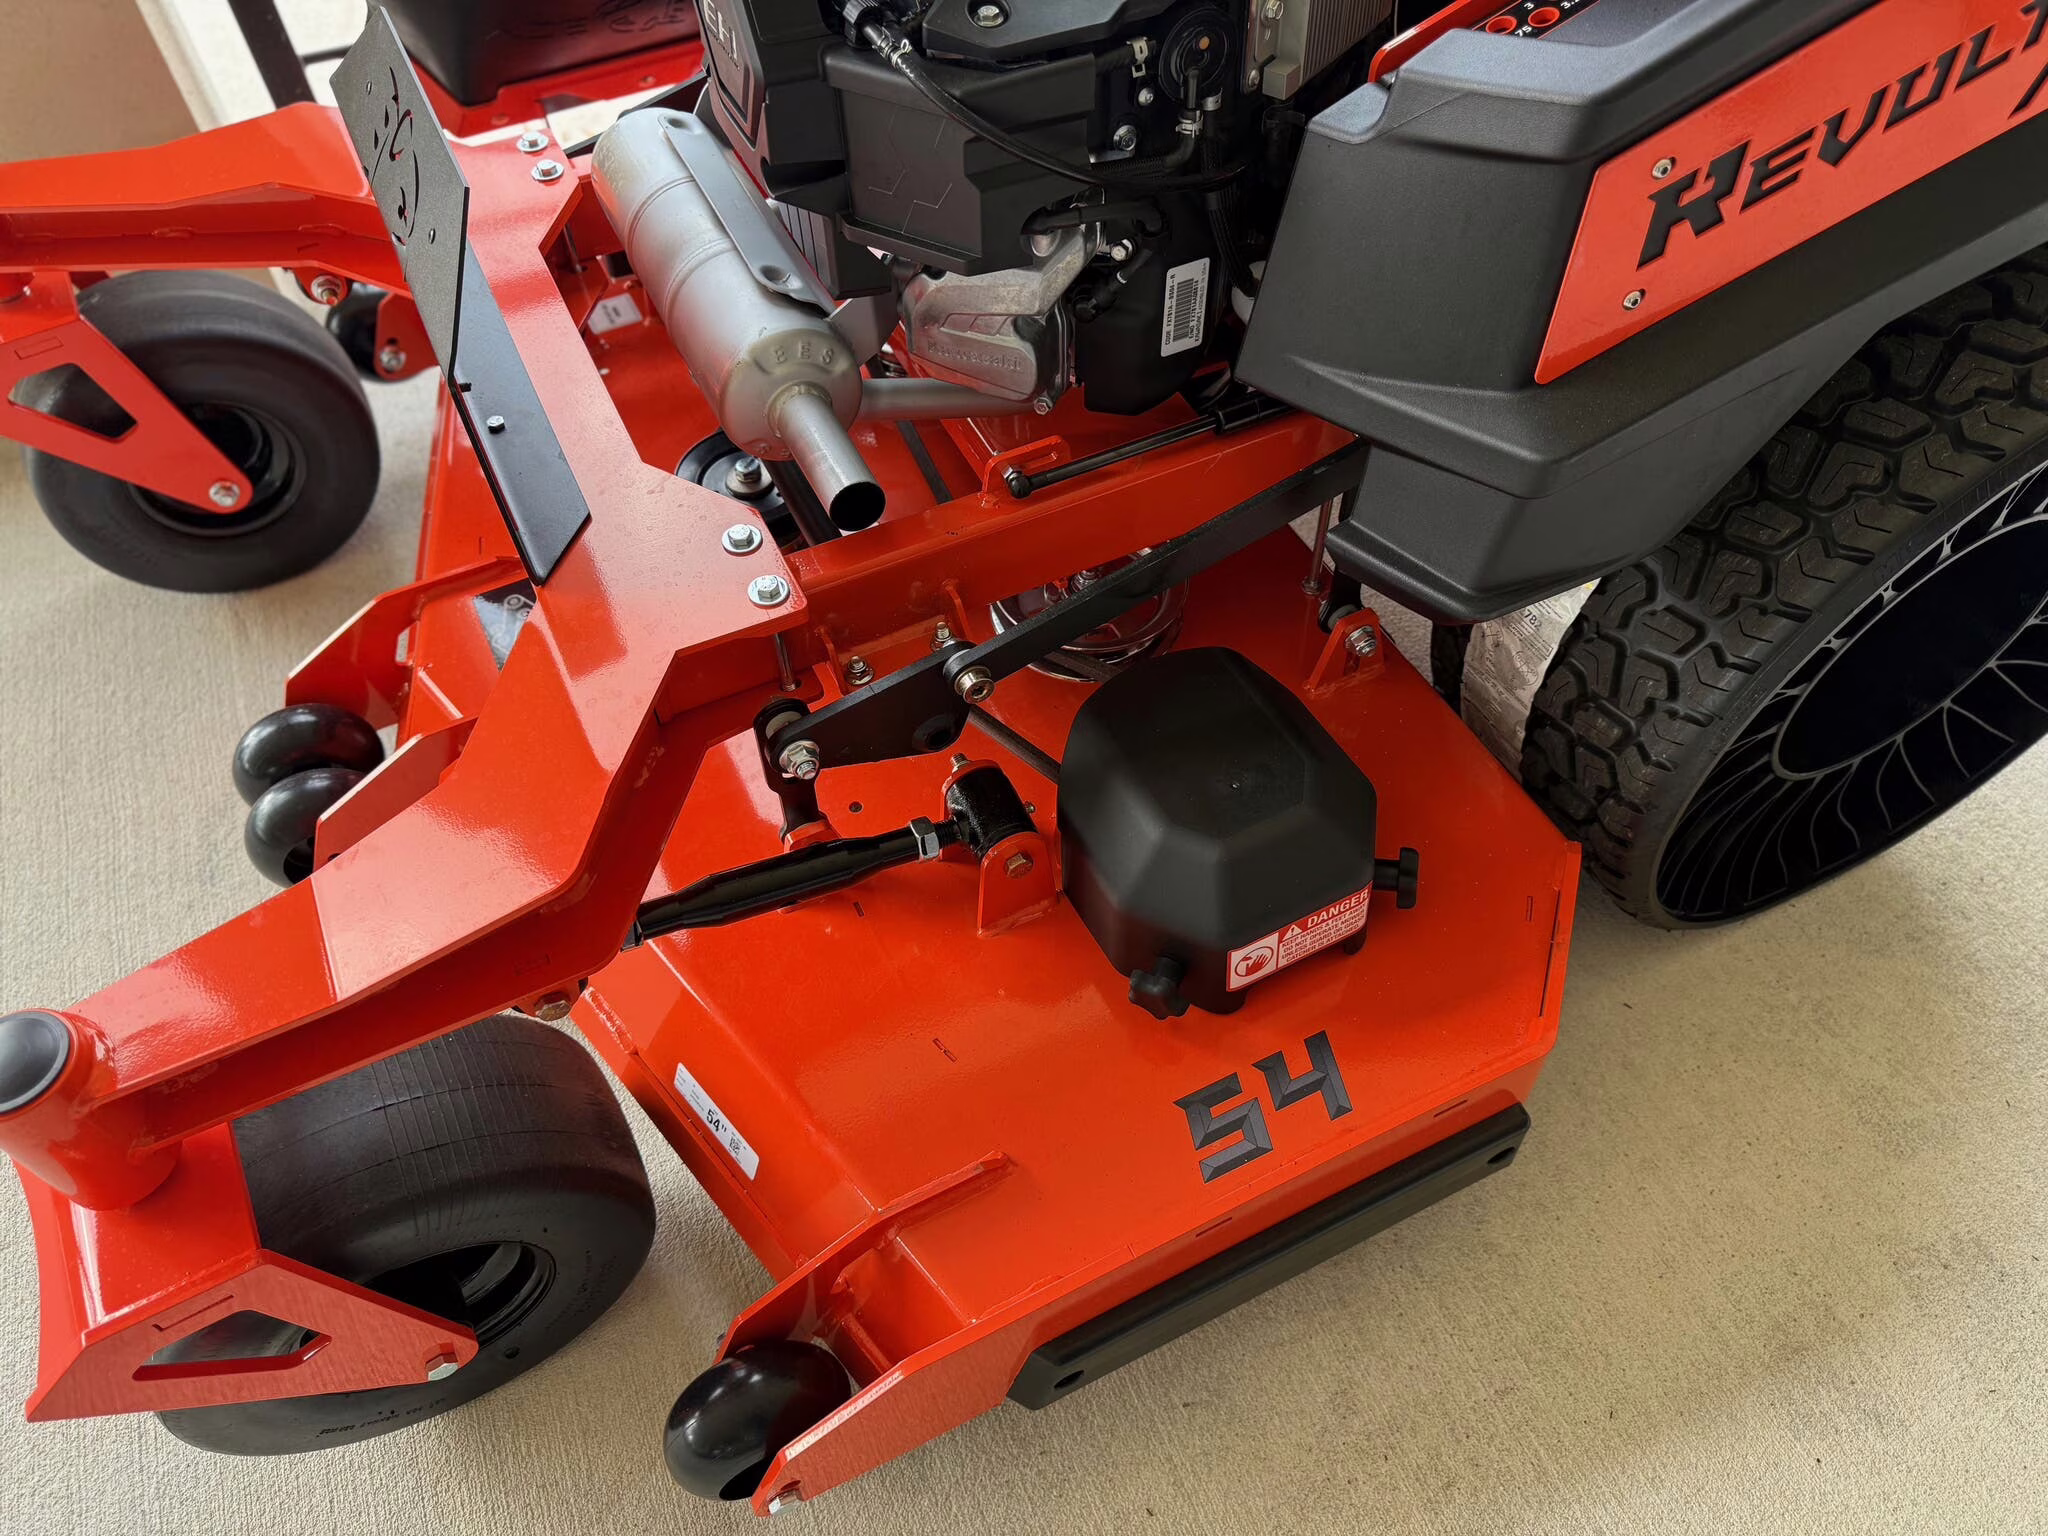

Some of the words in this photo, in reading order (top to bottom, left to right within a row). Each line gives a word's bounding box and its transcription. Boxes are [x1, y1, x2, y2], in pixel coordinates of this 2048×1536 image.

[1523, 2, 1535, 10] 3
[1308, 889, 1368, 928] DANGER
[1282, 936, 1299, 947] KEEP
[1300, 925, 1324, 939] HANDS
[1295, 938, 1309, 948] NOT
[1310, 925, 1338, 940] OPERATE
[1172, 1029, 1353, 1184] 54
